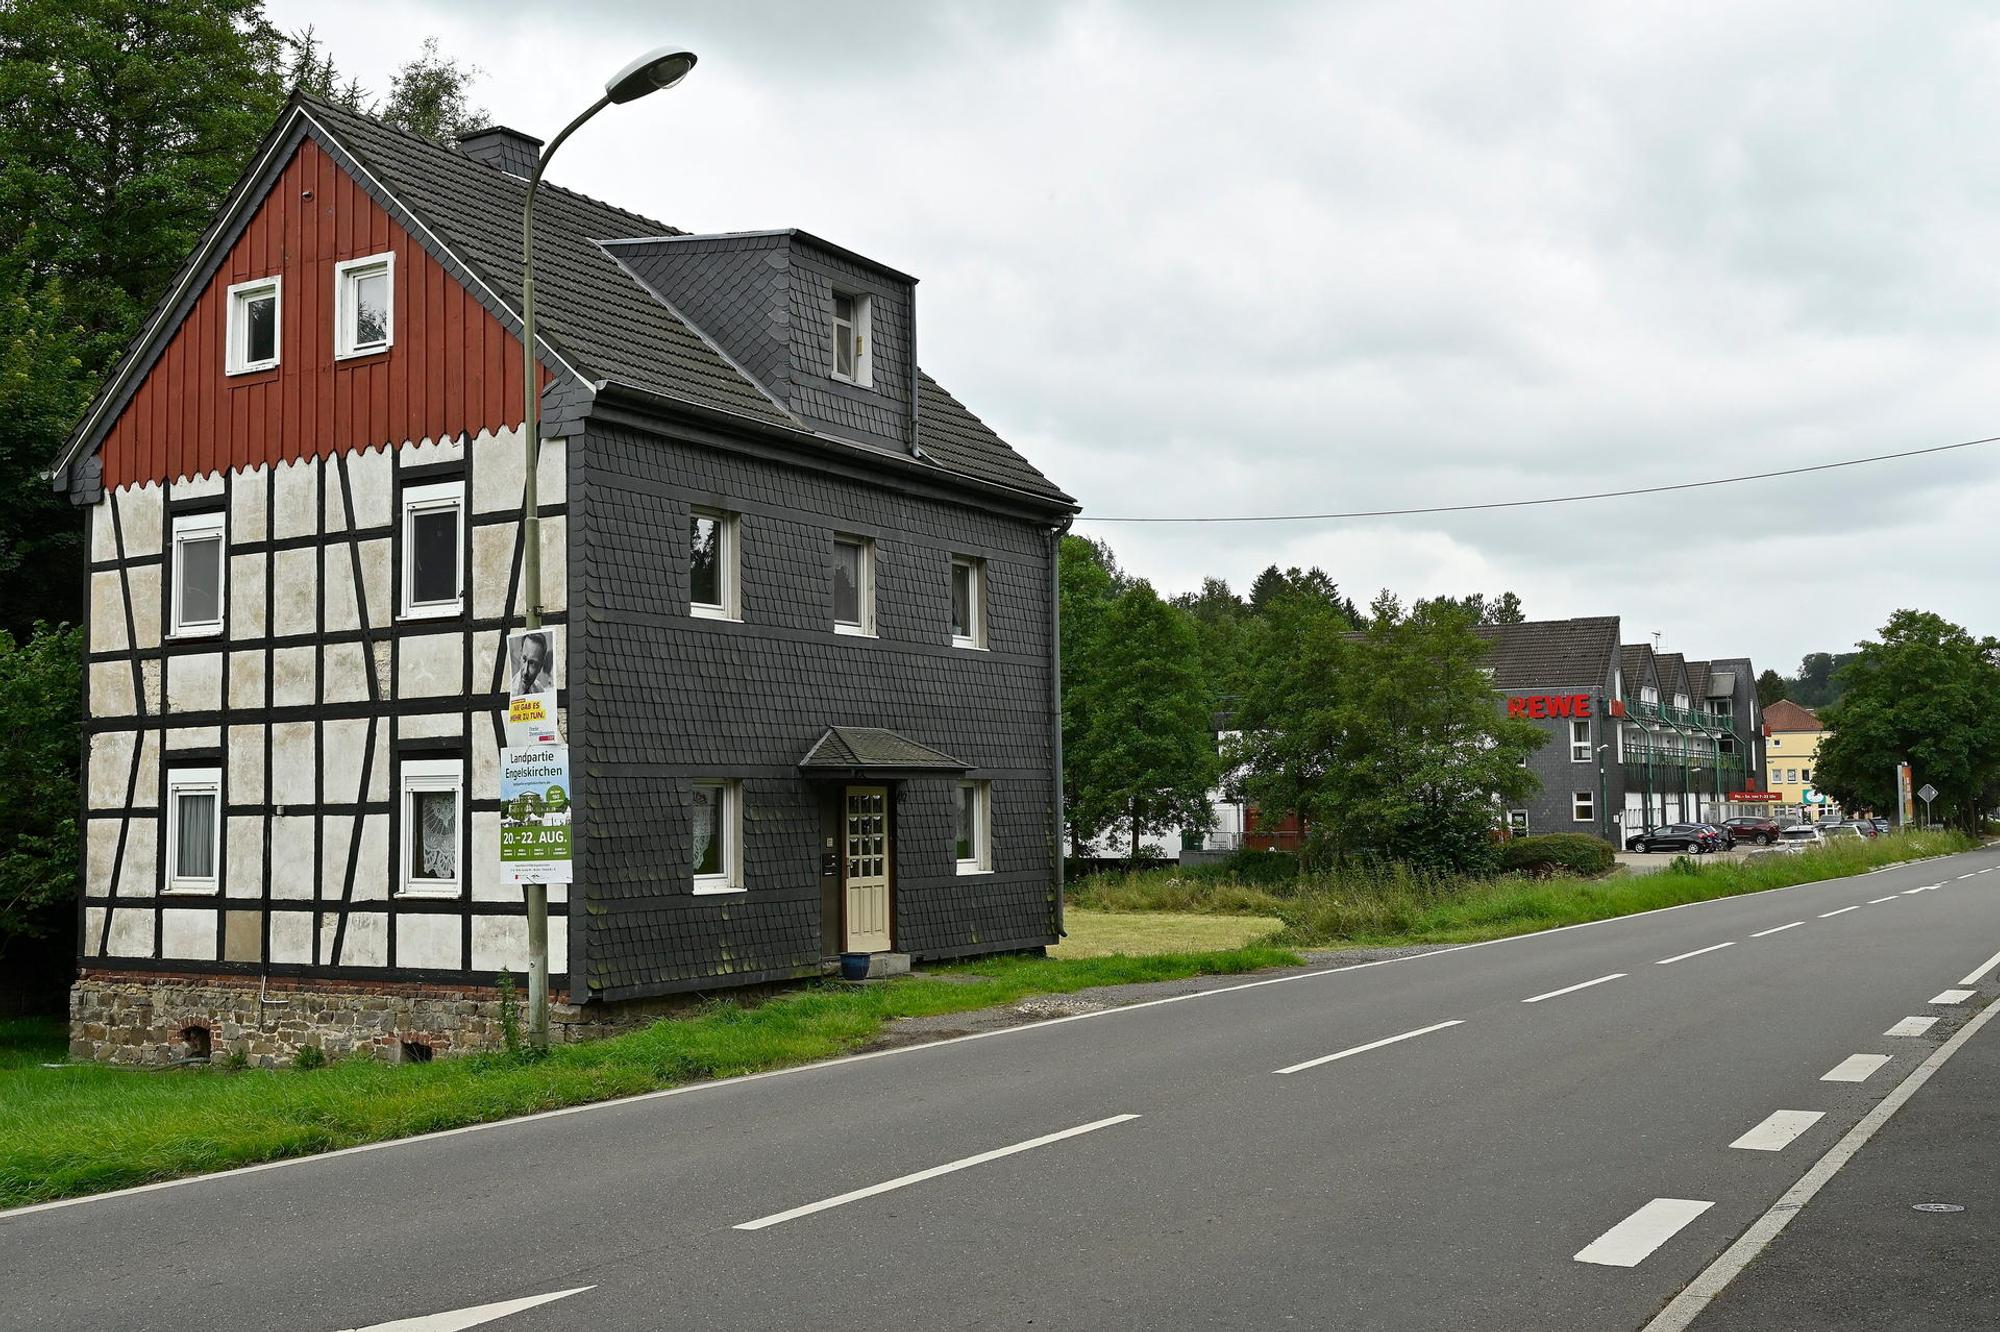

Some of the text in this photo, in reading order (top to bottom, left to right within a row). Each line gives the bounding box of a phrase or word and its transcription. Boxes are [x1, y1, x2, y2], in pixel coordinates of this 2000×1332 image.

[1507, 694, 1592, 719] REWE
[510, 751, 554, 764] Landpartie
[505, 766, 562, 780] Engelskirchen
[539, 830, 567, 843] AUG.
